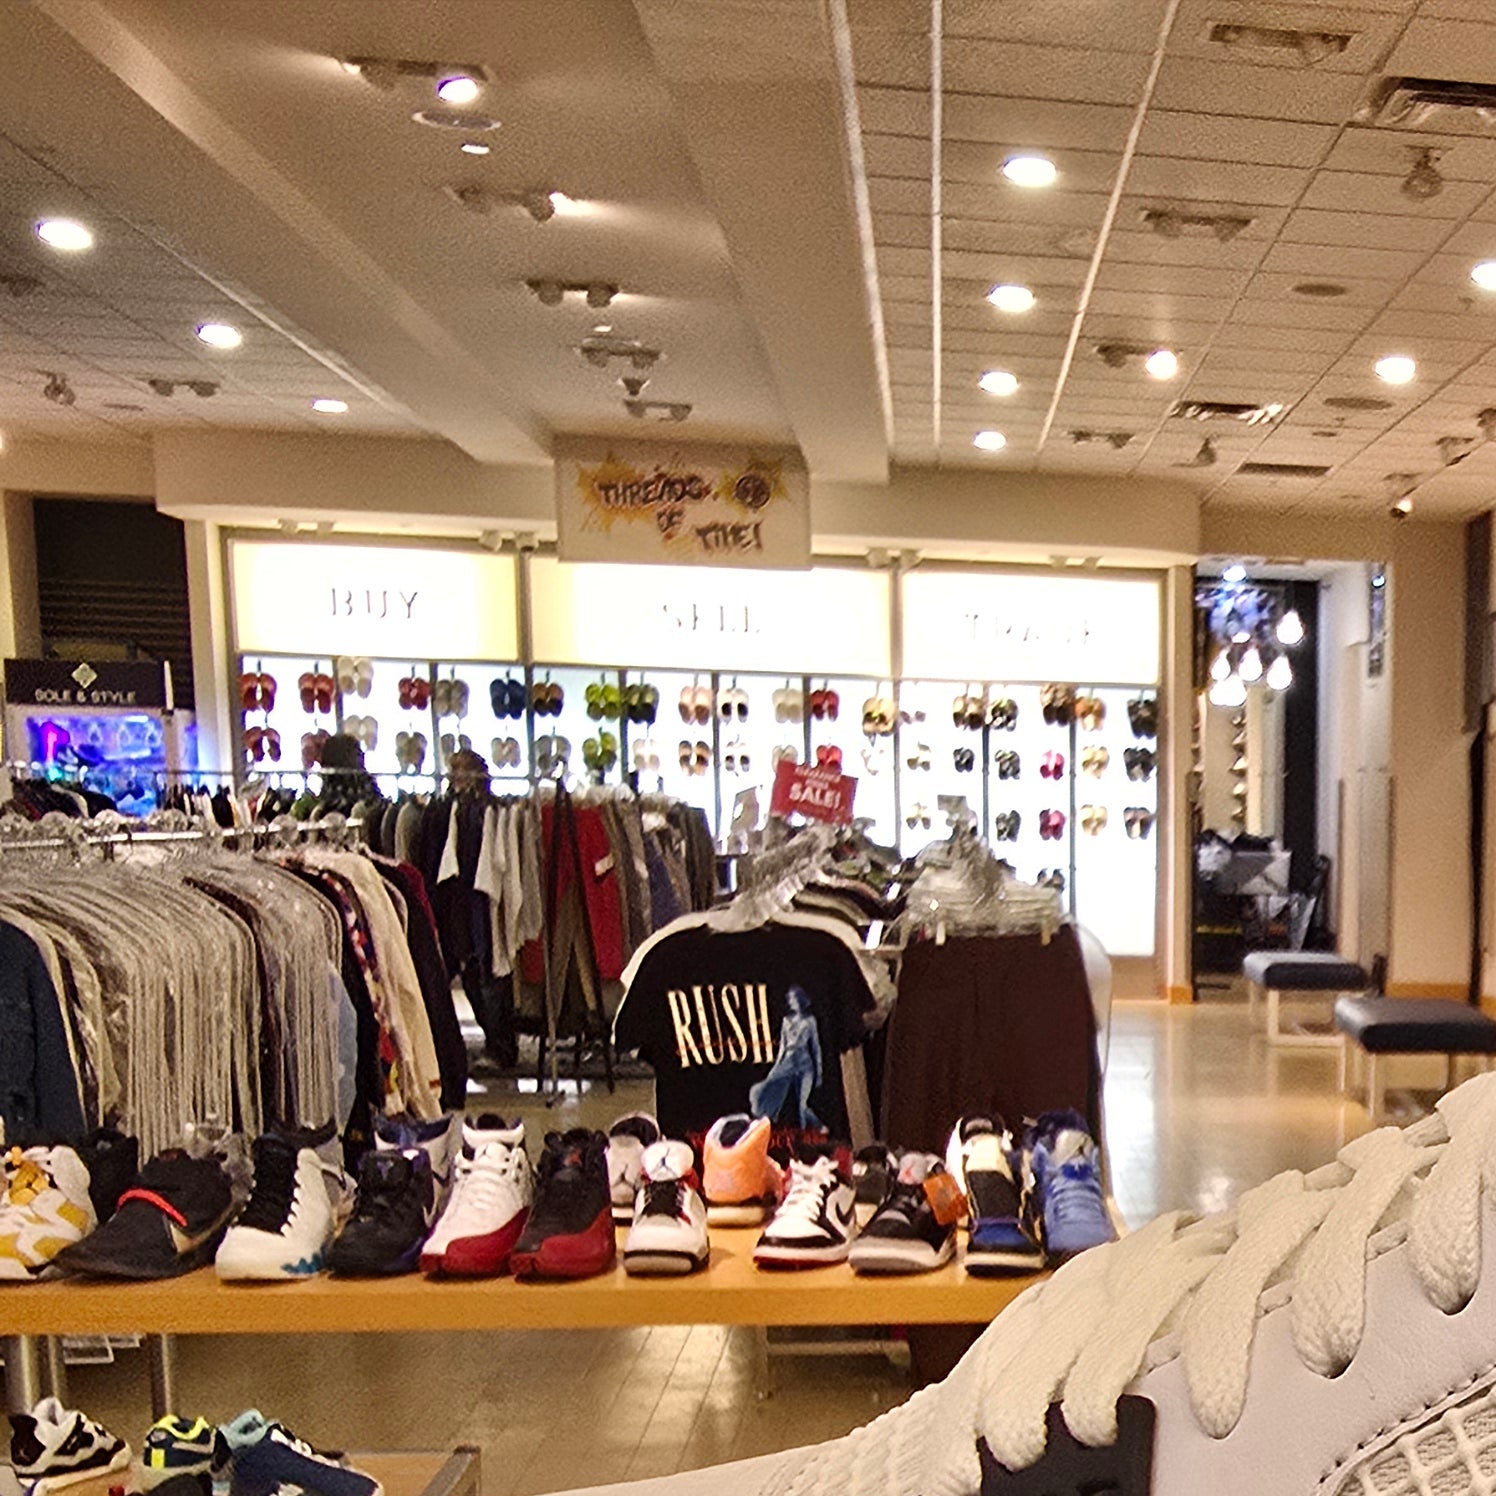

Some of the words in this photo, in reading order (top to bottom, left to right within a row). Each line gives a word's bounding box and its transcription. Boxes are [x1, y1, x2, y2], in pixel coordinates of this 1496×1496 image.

[331, 587, 418, 619] BUY
[35, 688, 71, 702] SOLE
[91, 689, 136, 704] STYLE
[667, 983, 775, 1068] RUSH
